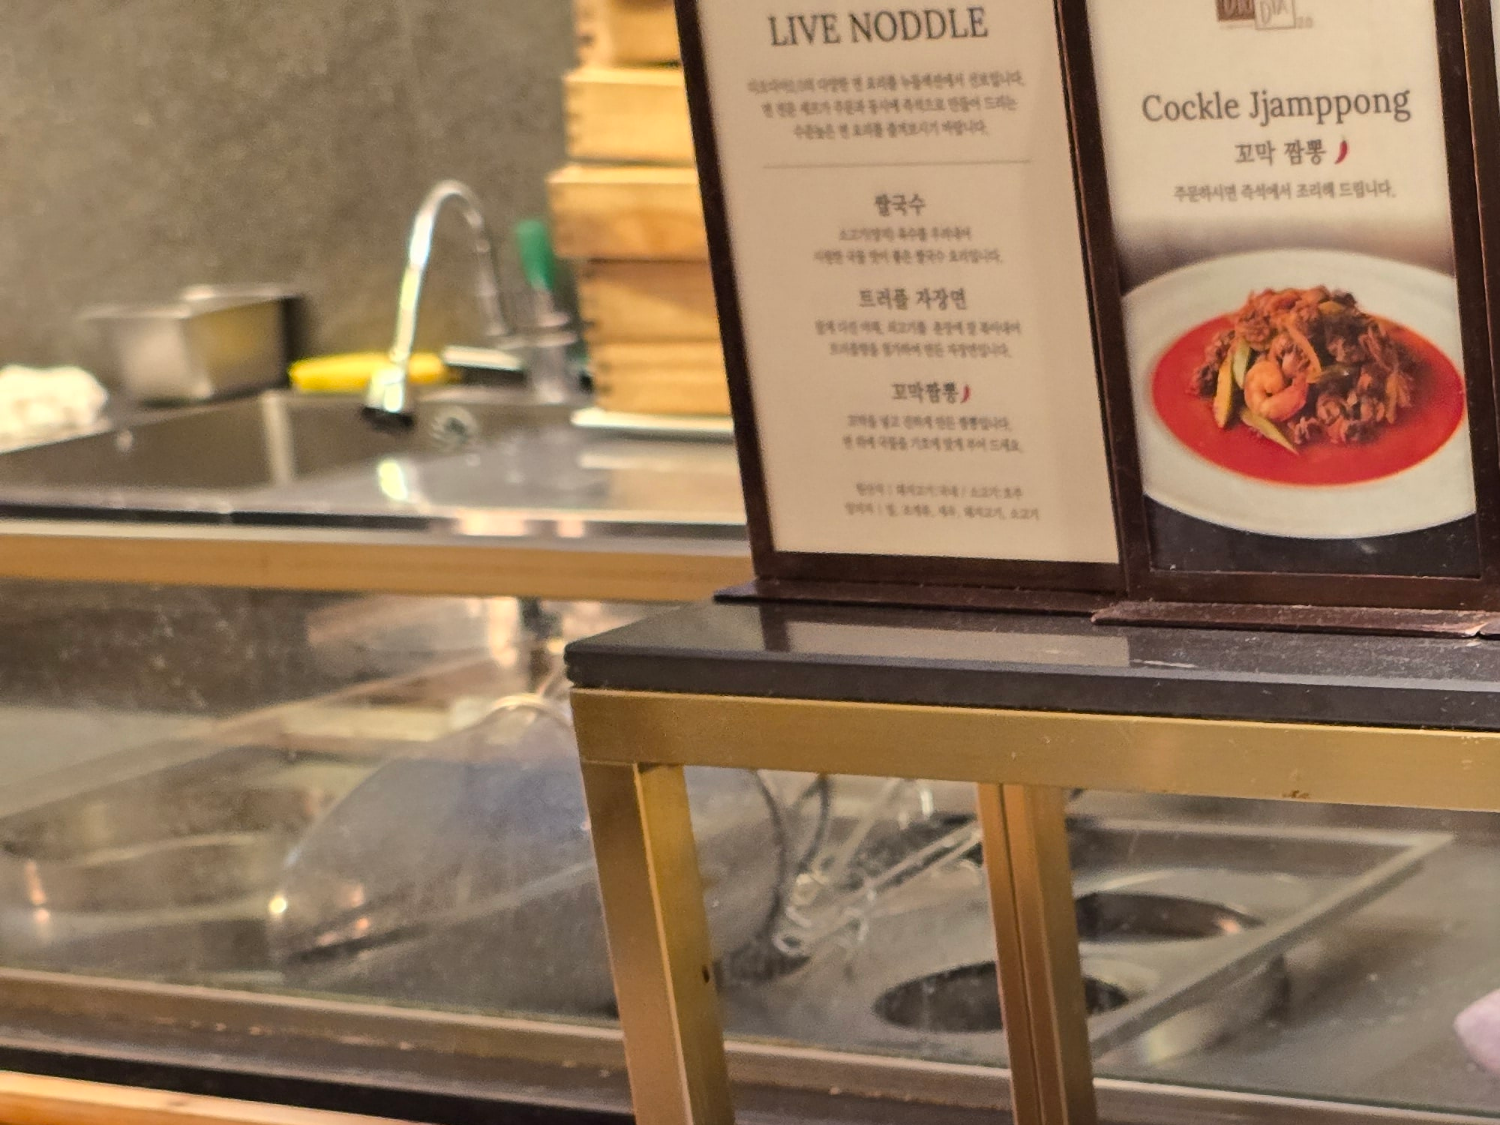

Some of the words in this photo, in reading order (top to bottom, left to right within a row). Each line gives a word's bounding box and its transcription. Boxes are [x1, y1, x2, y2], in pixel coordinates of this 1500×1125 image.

[768, 13, 841, 46] LIVE
[850, 7, 988, 43] NODDLE
[1142, 91, 1241, 121] Cockle
[1249, 89, 1411, 127] Jjamppong
[1235, 141, 1275, 166] 꼬막
[1284, 139, 1327, 166] 짬뽕
[1173, 183, 1237, 202] 주문하시면
[1241, 182, 1292, 200] 즉석에서
[1296, 181, 1335, 200] 조리해
[1339, 179, 1397, 198] 드립니다.
[875, 193, 926, 217] 쌀국수
[859, 287, 909, 310] 트러플
[915, 287, 967, 310] 자장면
[892, 381, 958, 404] 꼬막짬뽕
